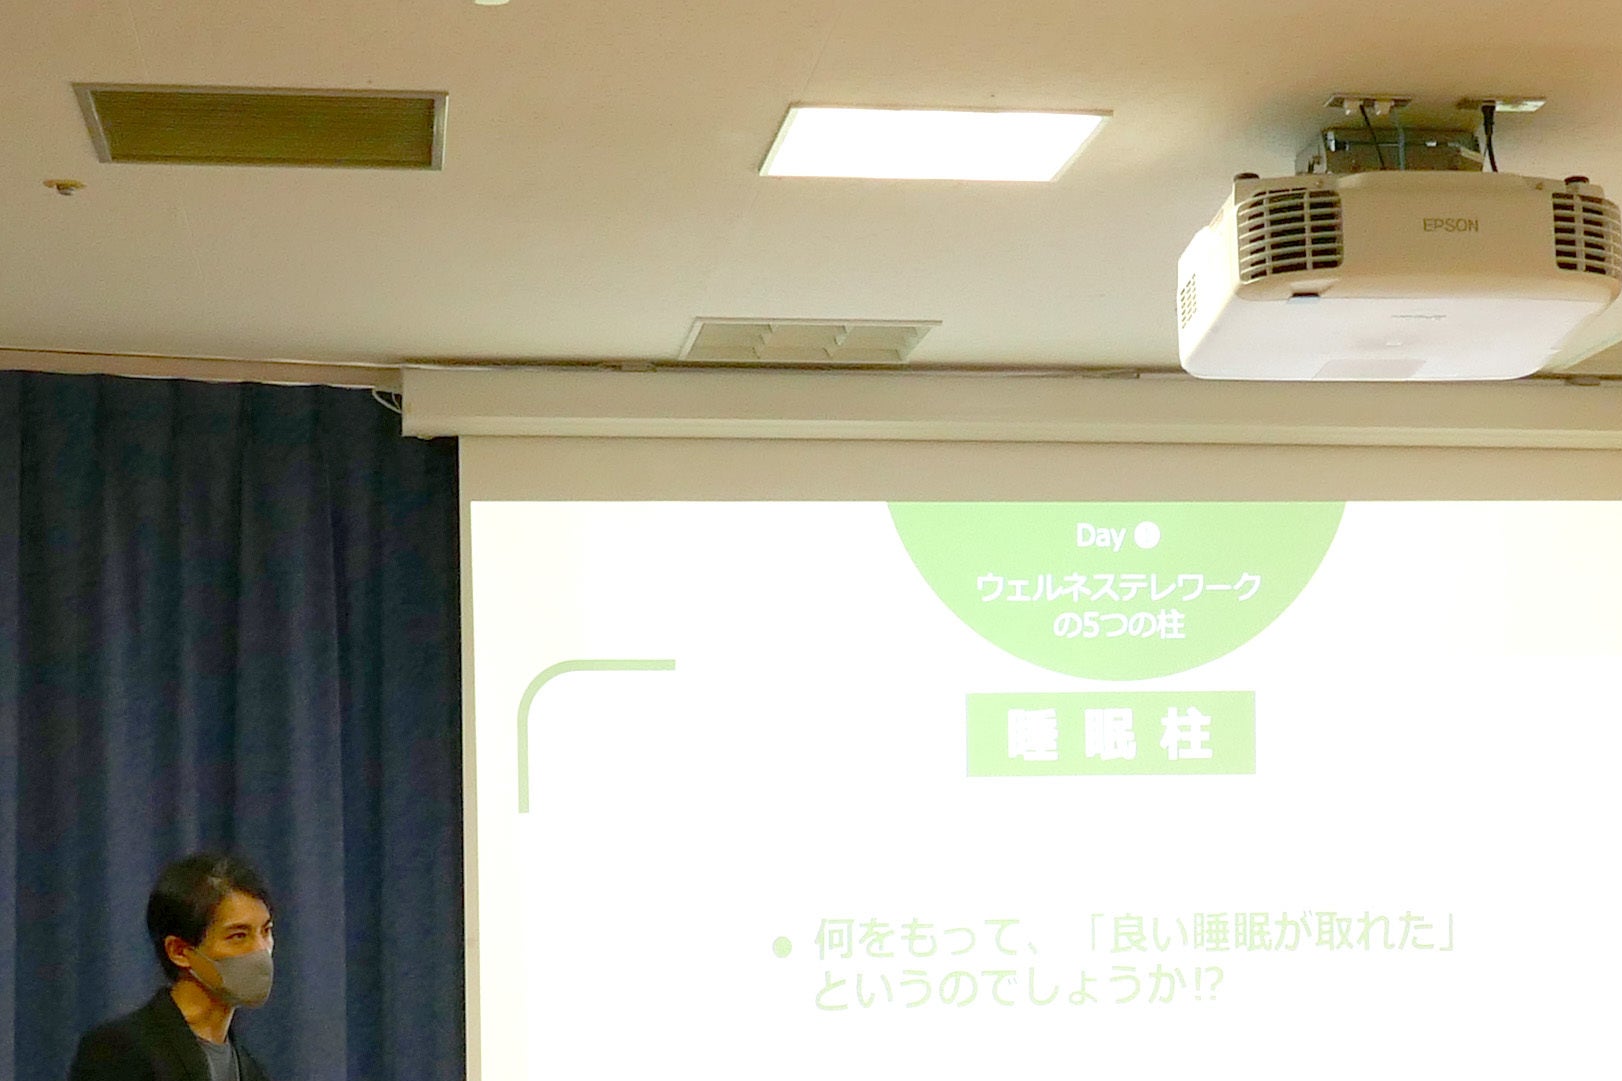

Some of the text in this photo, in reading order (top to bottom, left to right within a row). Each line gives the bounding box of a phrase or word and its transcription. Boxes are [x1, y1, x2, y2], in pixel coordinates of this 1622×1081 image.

[1423, 217, 1479, 232] EPSON
[1076, 522, 1127, 552] Day
[976, 572, 1262, 602] ウェルネステレワーク
[1053, 608, 1186, 640] の5つの柱
